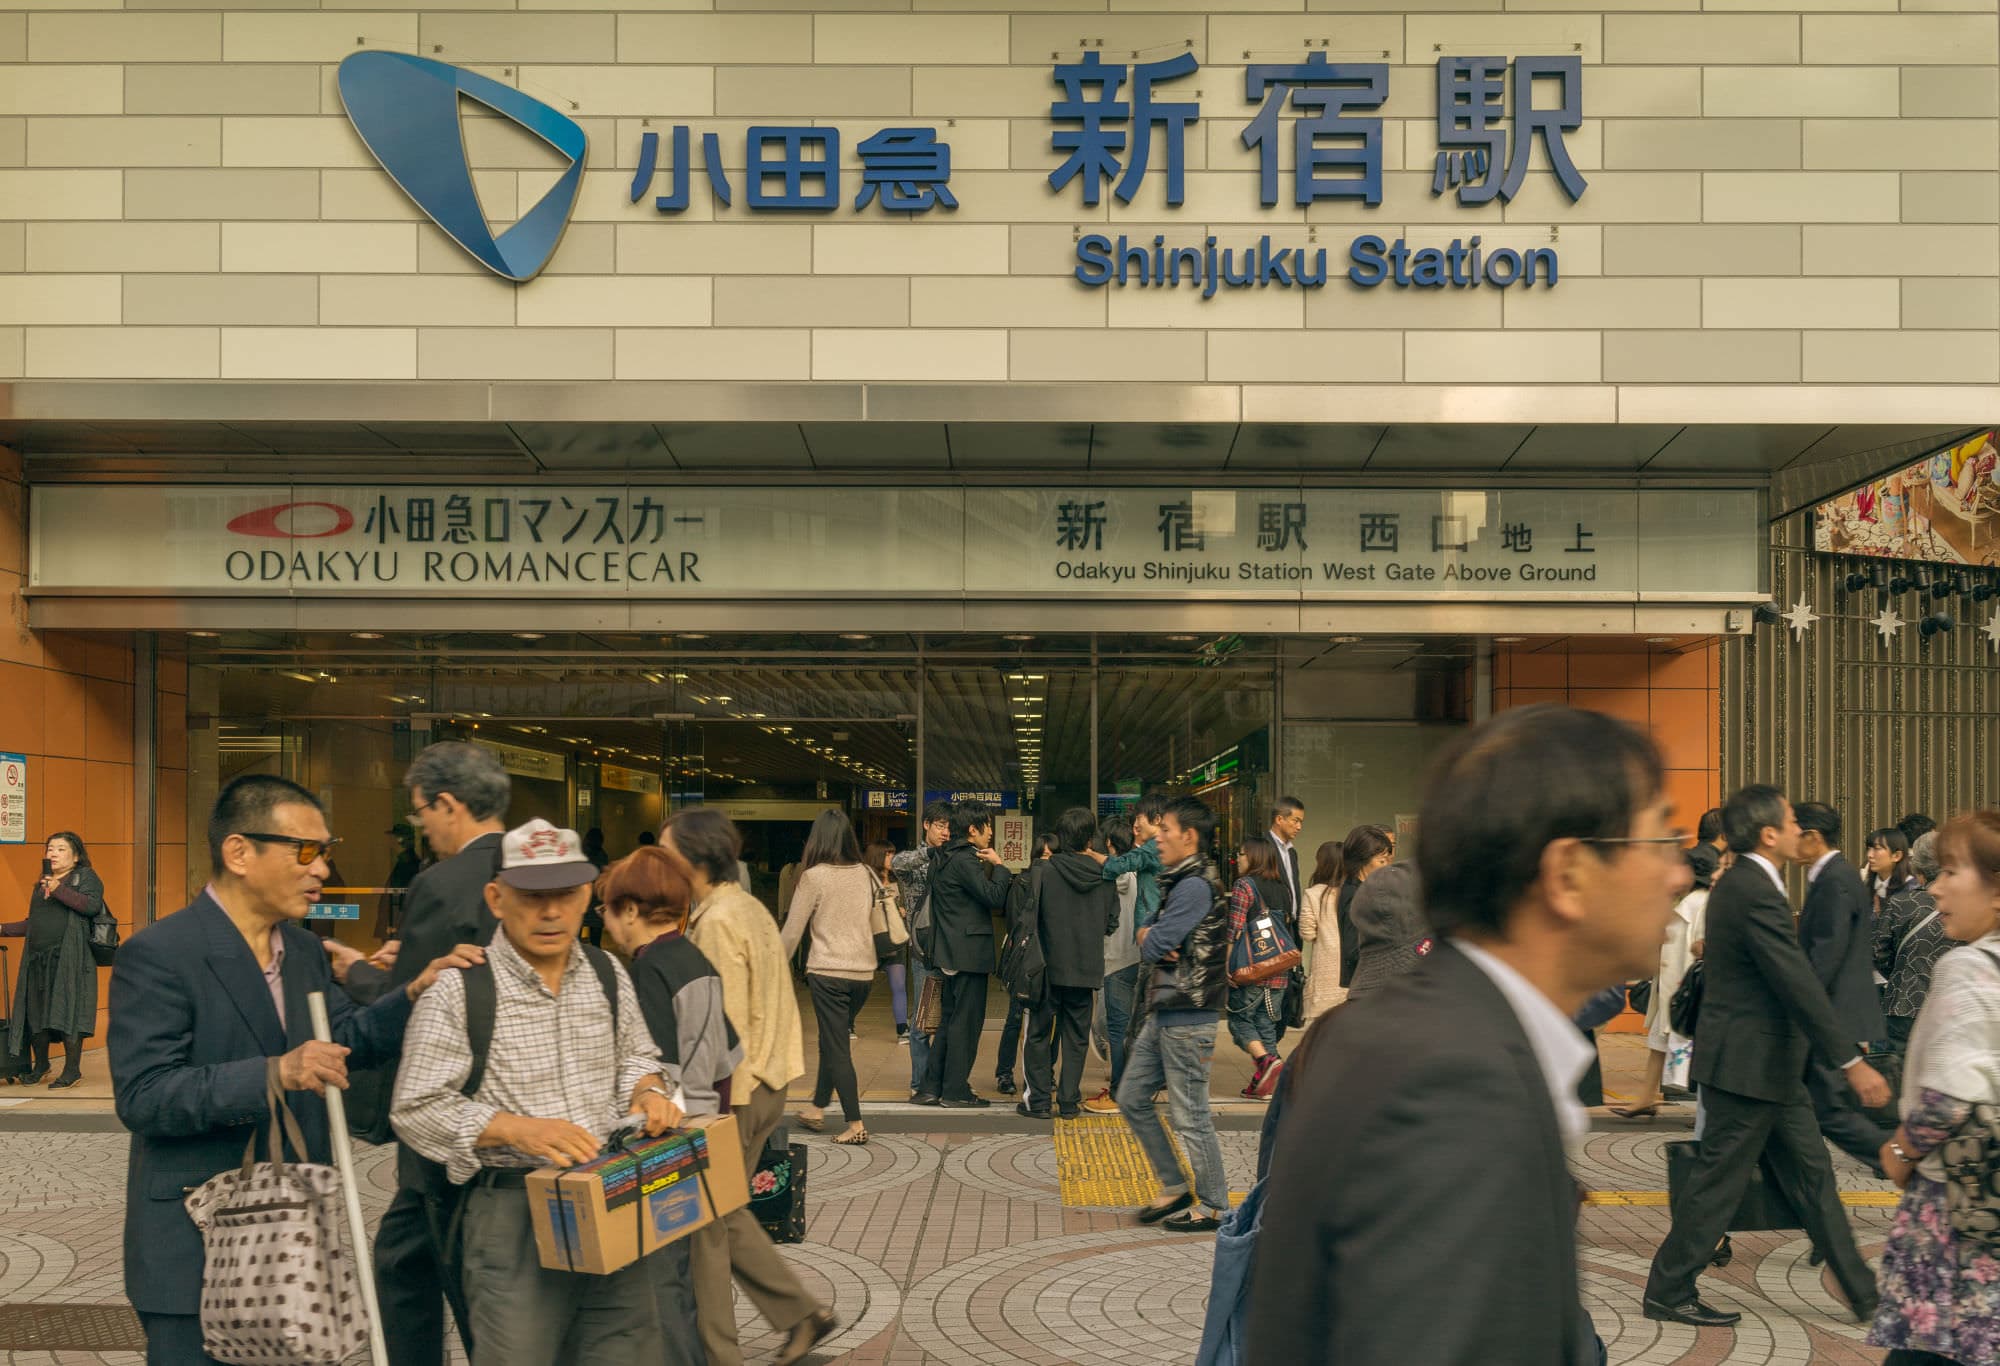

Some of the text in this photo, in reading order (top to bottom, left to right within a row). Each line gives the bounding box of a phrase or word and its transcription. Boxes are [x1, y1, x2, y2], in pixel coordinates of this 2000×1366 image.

[630, 50, 1587, 215] 小田急 新宿駅
[1075, 234, 1558, 298] Shinjuku Station
[364, 494, 704, 545] 小田急ロマンスカー
[225, 550, 702, 583] ODAKYU ROMANCECAR
[1055, 561, 1596, 583] Odakyu Shinjuku Station West Gate Above Ground
[1003, 821, 1024, 862] 閉鎖
